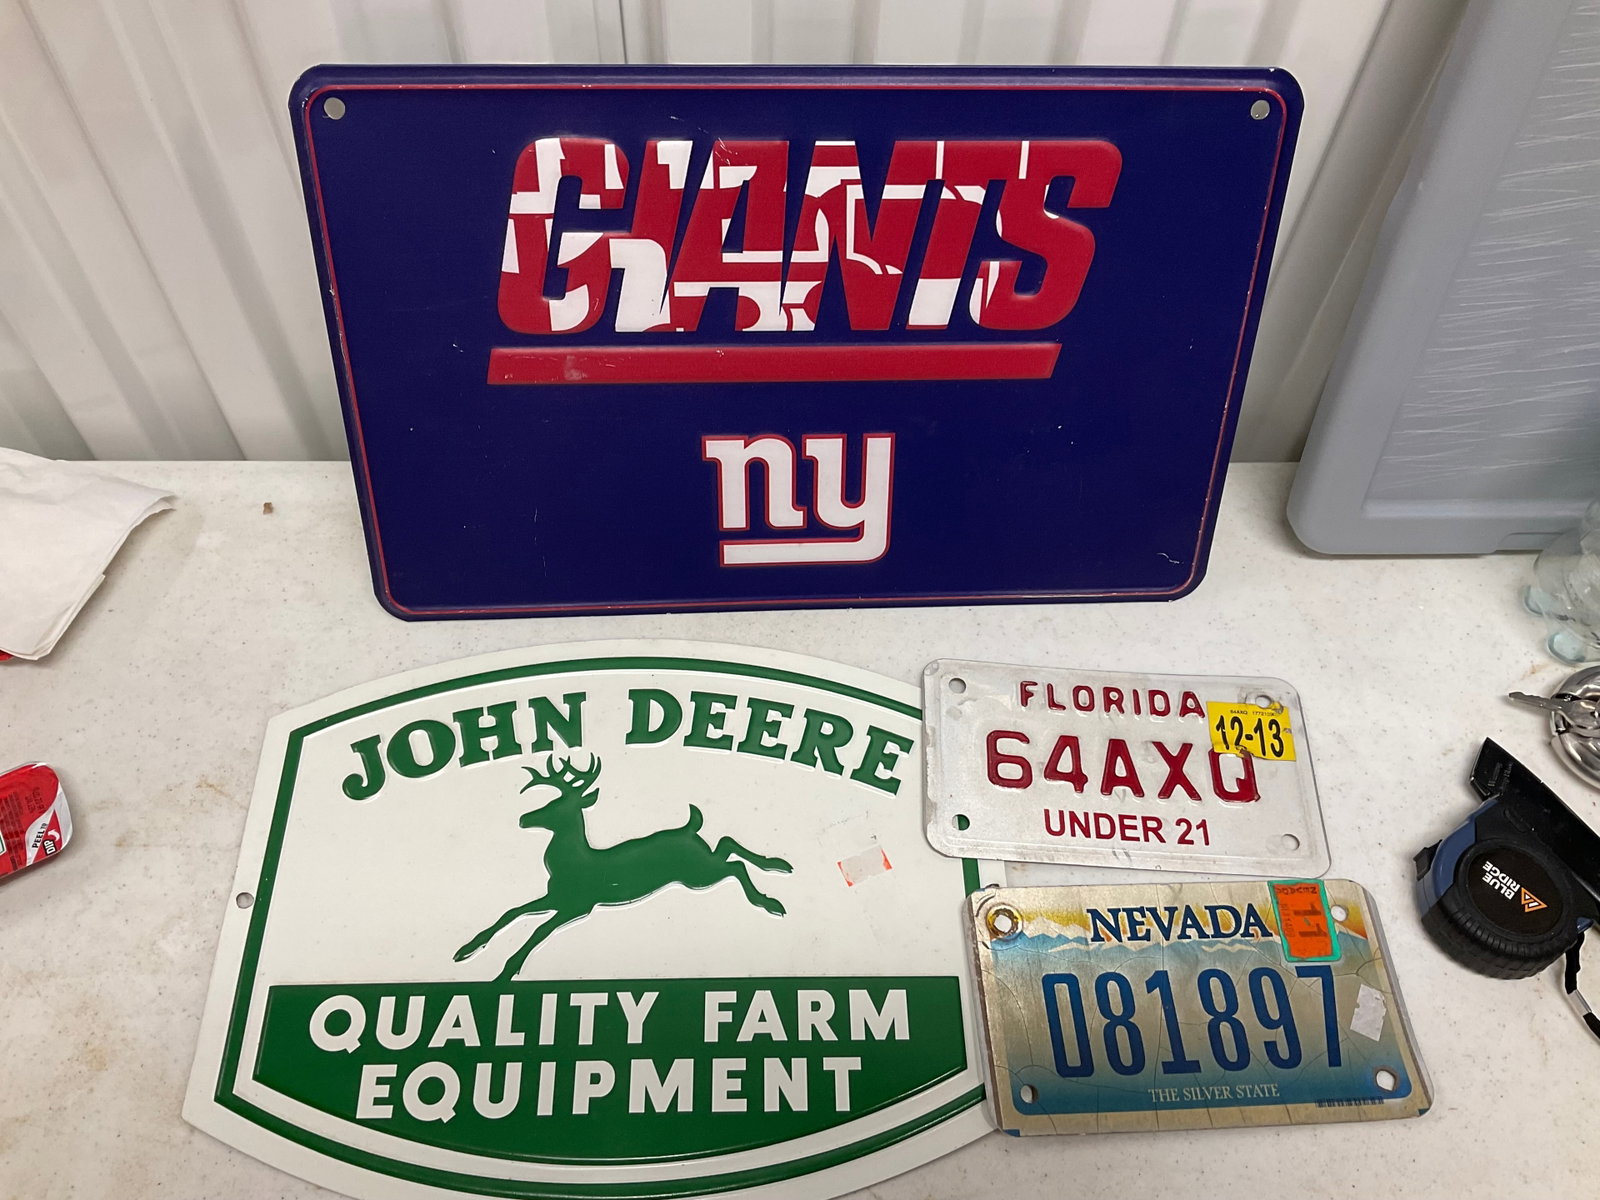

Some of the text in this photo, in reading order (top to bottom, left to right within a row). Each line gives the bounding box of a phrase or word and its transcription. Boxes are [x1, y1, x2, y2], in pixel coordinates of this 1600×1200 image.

[496, 136, 1124, 335] GIANTS
[1019, 680, 1206, 719] FLORIDA
[342, 687, 915, 801] JOHN DEERE
[1215, 714, 1284, 758] 12-13
[986, 729, 1261, 803] 64AXQ
[32, 830, 46, 848] PEEL
[43, 839, 56, 855] DIP
[1043, 808, 1210, 847] UNDER 21
[1481, 872, 1516, 900] BLUE
[1482, 860, 1521, 893] RIDGE
[1086, 903, 1273, 943] NEVADA
[308, 988, 910, 1054] QUALITY FARM
[1041, 965, 1343, 1079] 081897
[354, 1056, 863, 1124] EQUIPMENT
[1147, 1082, 1281, 1103] THE SILVER STATE
